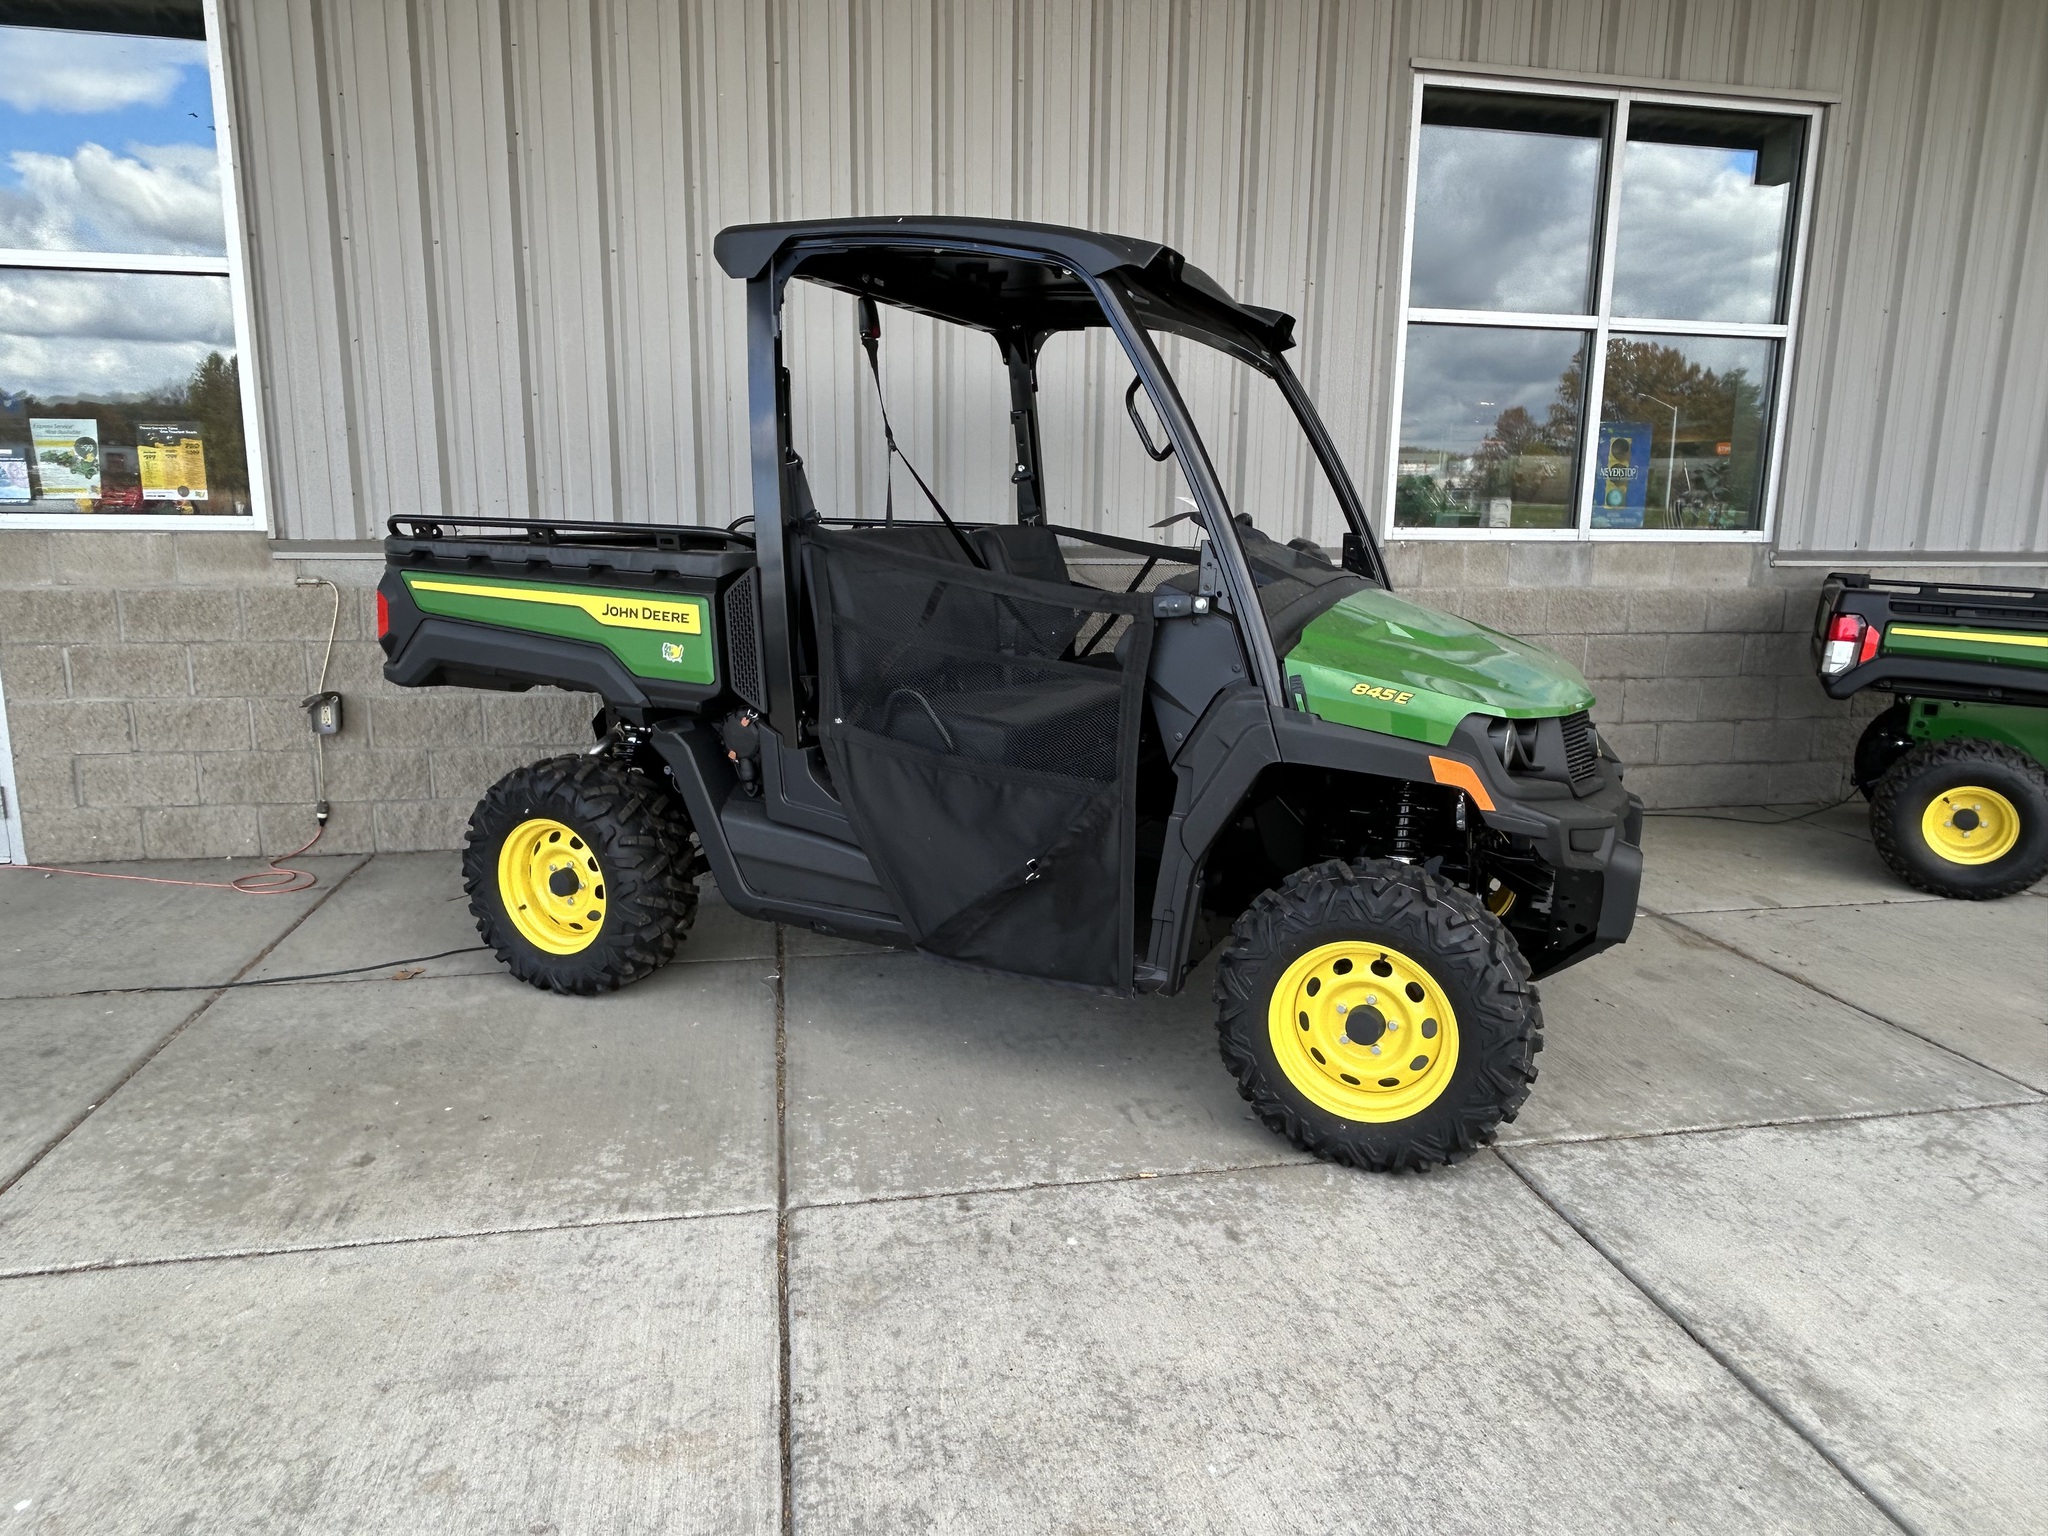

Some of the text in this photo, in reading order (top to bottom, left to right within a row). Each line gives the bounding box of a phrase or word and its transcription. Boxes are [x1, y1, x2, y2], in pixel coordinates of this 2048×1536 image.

[602, 603, 690, 624] JOHN DEERE
[1351, 683, 1414, 704] 845E
